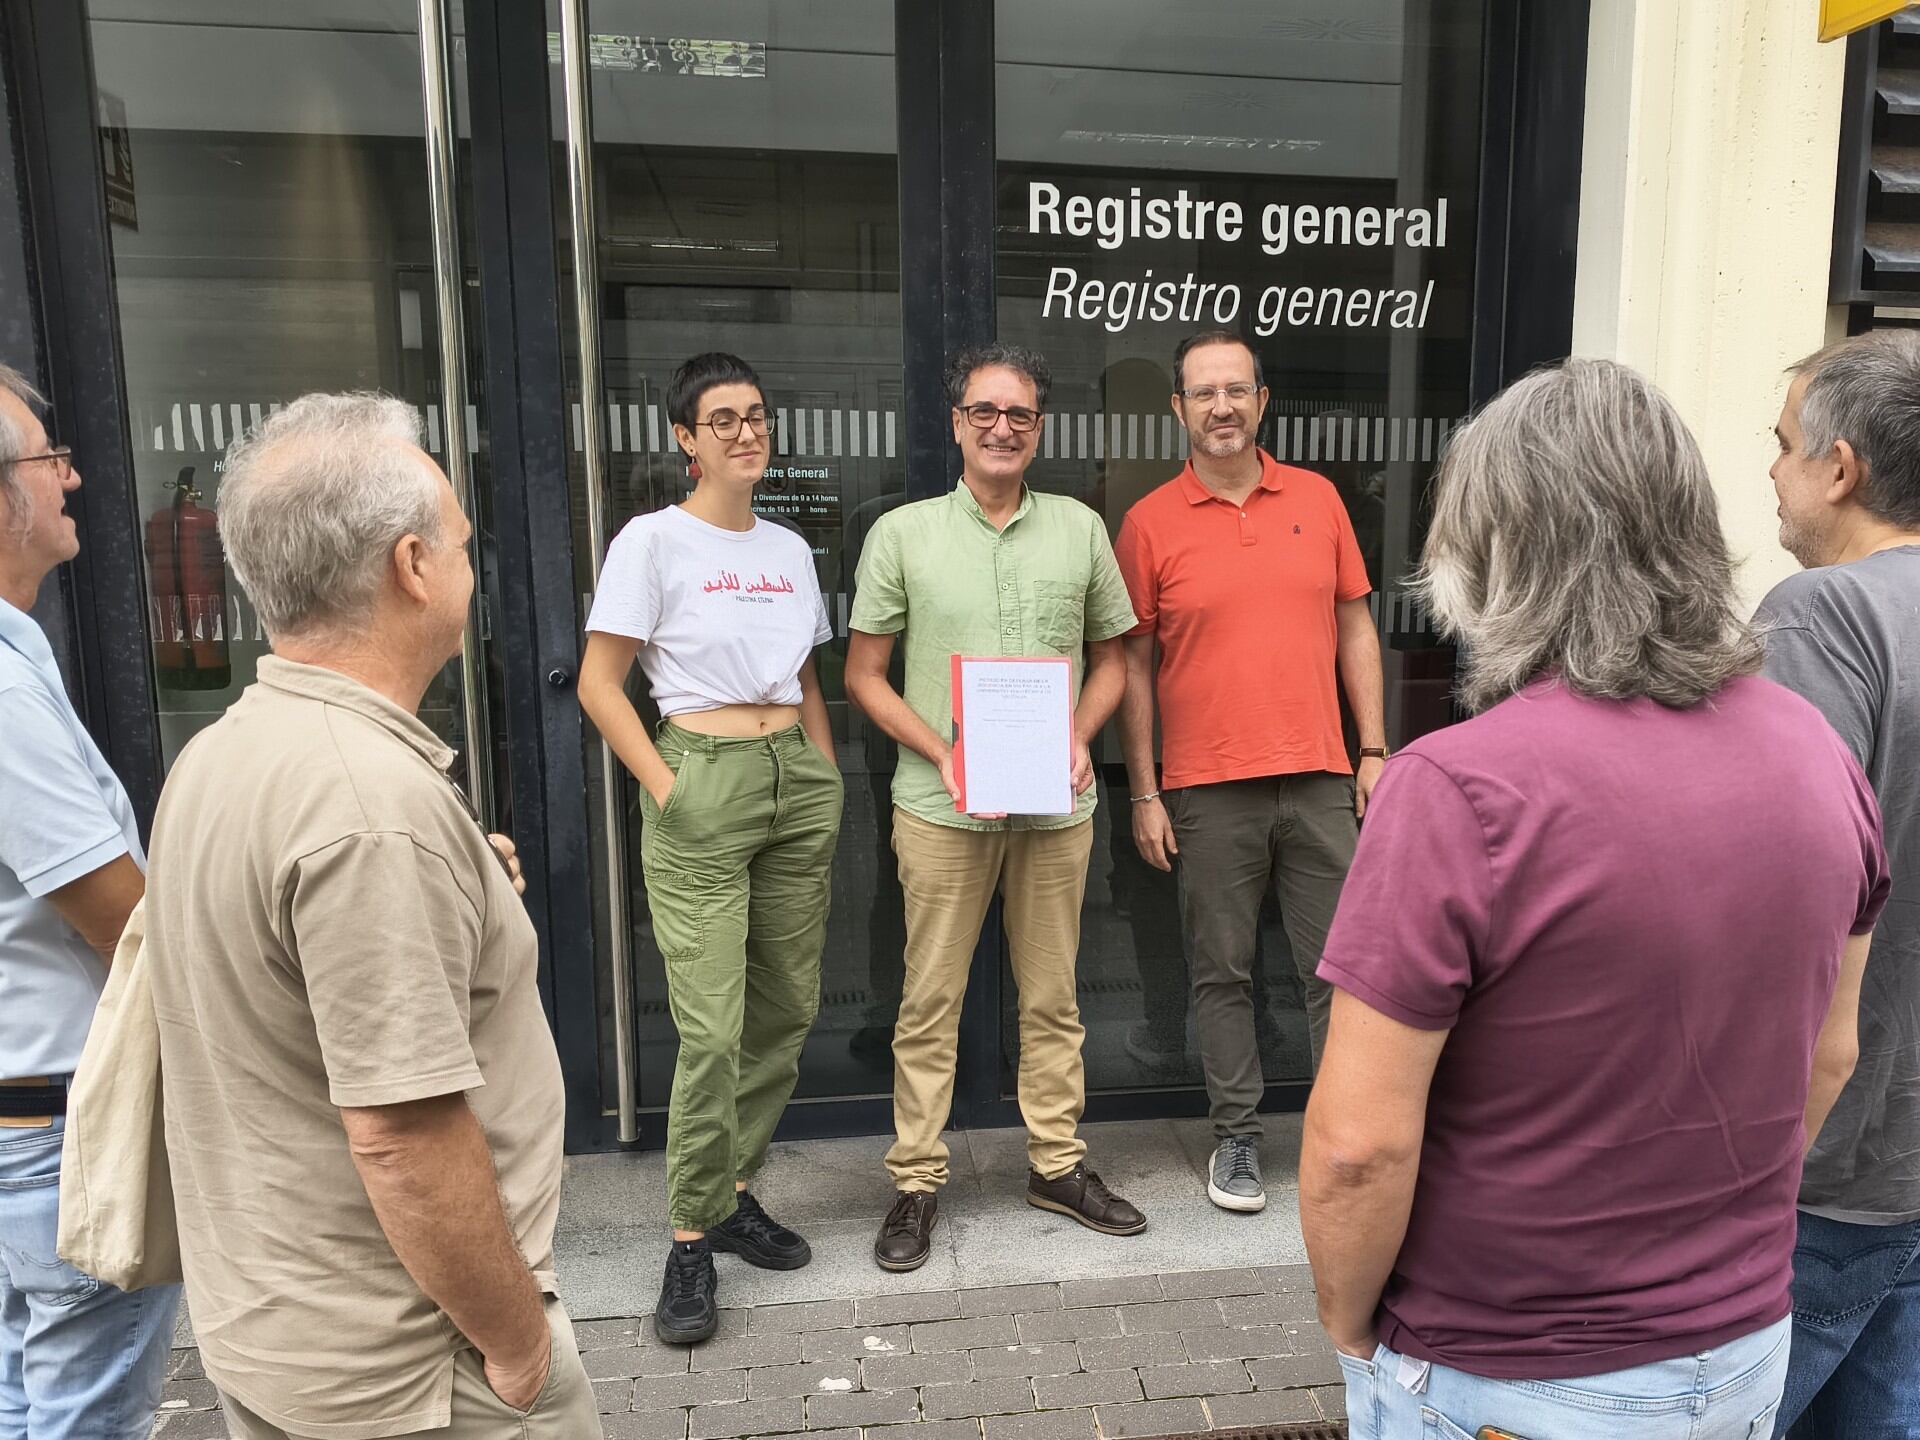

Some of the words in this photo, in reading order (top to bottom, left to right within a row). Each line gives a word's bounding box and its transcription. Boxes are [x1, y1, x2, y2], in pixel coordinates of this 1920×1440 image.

[1028, 181, 1243, 250] Registre
[1261, 197, 1448, 255] general
[1041, 266, 1241, 333] Registro
[1254, 280, 1435, 337] general
[787, 467, 829, 479] General
[811, 494, 820, 502] 14
[820, 494, 839, 502] hores
[809, 506, 828, 514] hores
[745, 573, 794, 594] فلسطين
